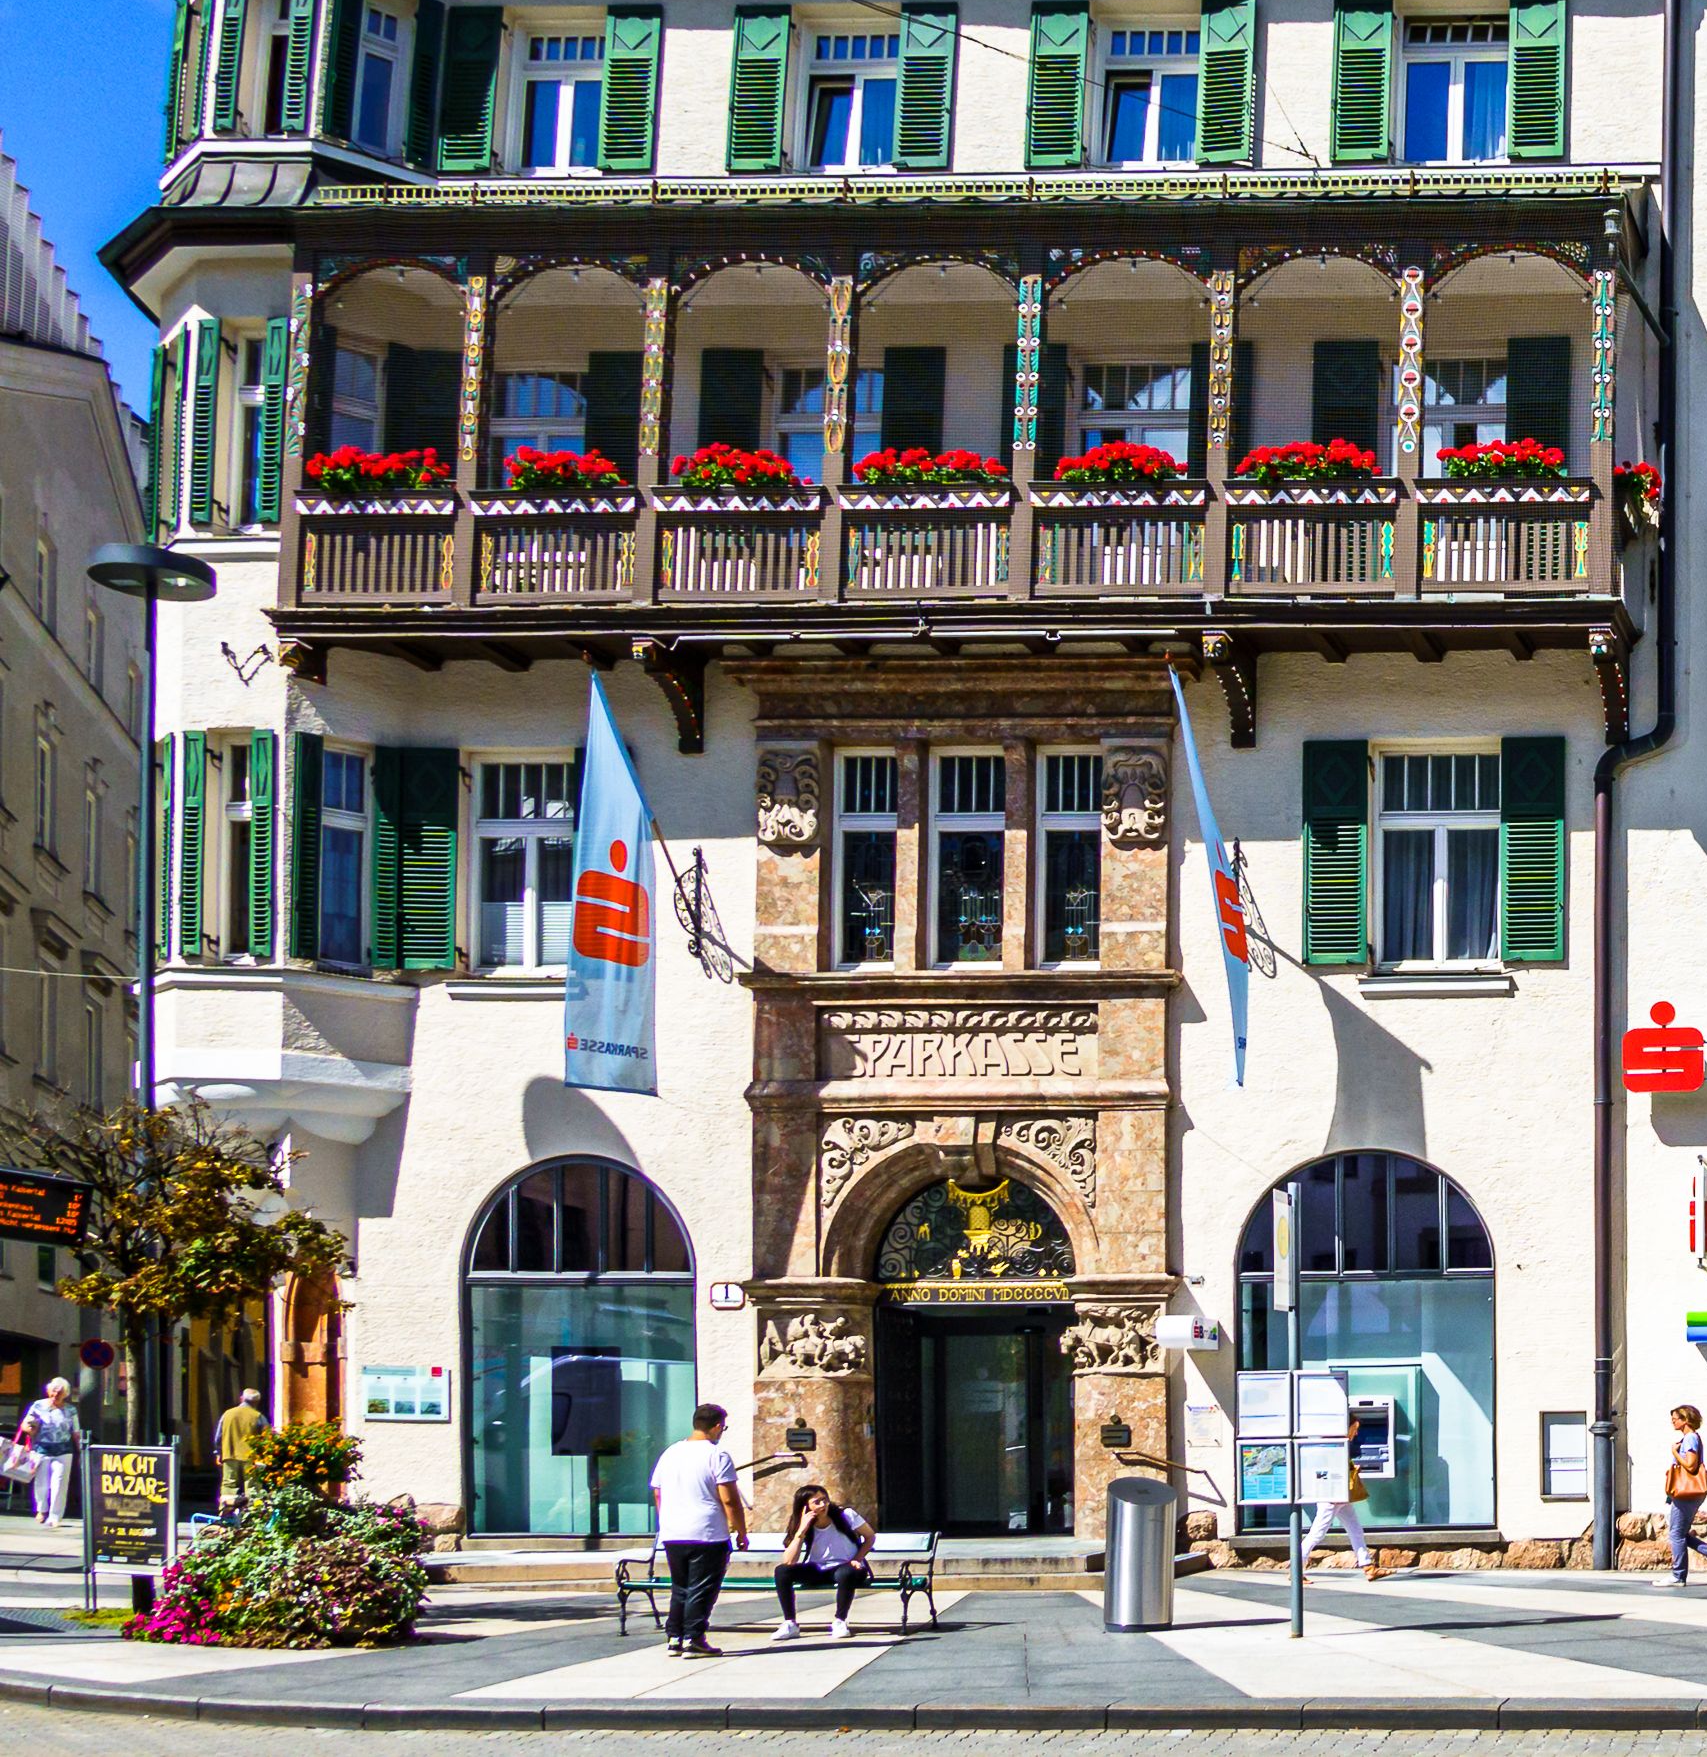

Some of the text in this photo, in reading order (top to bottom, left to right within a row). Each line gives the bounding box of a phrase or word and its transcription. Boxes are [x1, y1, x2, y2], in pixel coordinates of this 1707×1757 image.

[845, 1033, 1082, 1078] SPARKASSE
[890, 1289, 931, 1302] ANNO
[938, 1288, 986, 1302] DOMINI
[102, 1453, 158, 1476] NACHT
[102, 1474, 157, 1496] BAZAR
